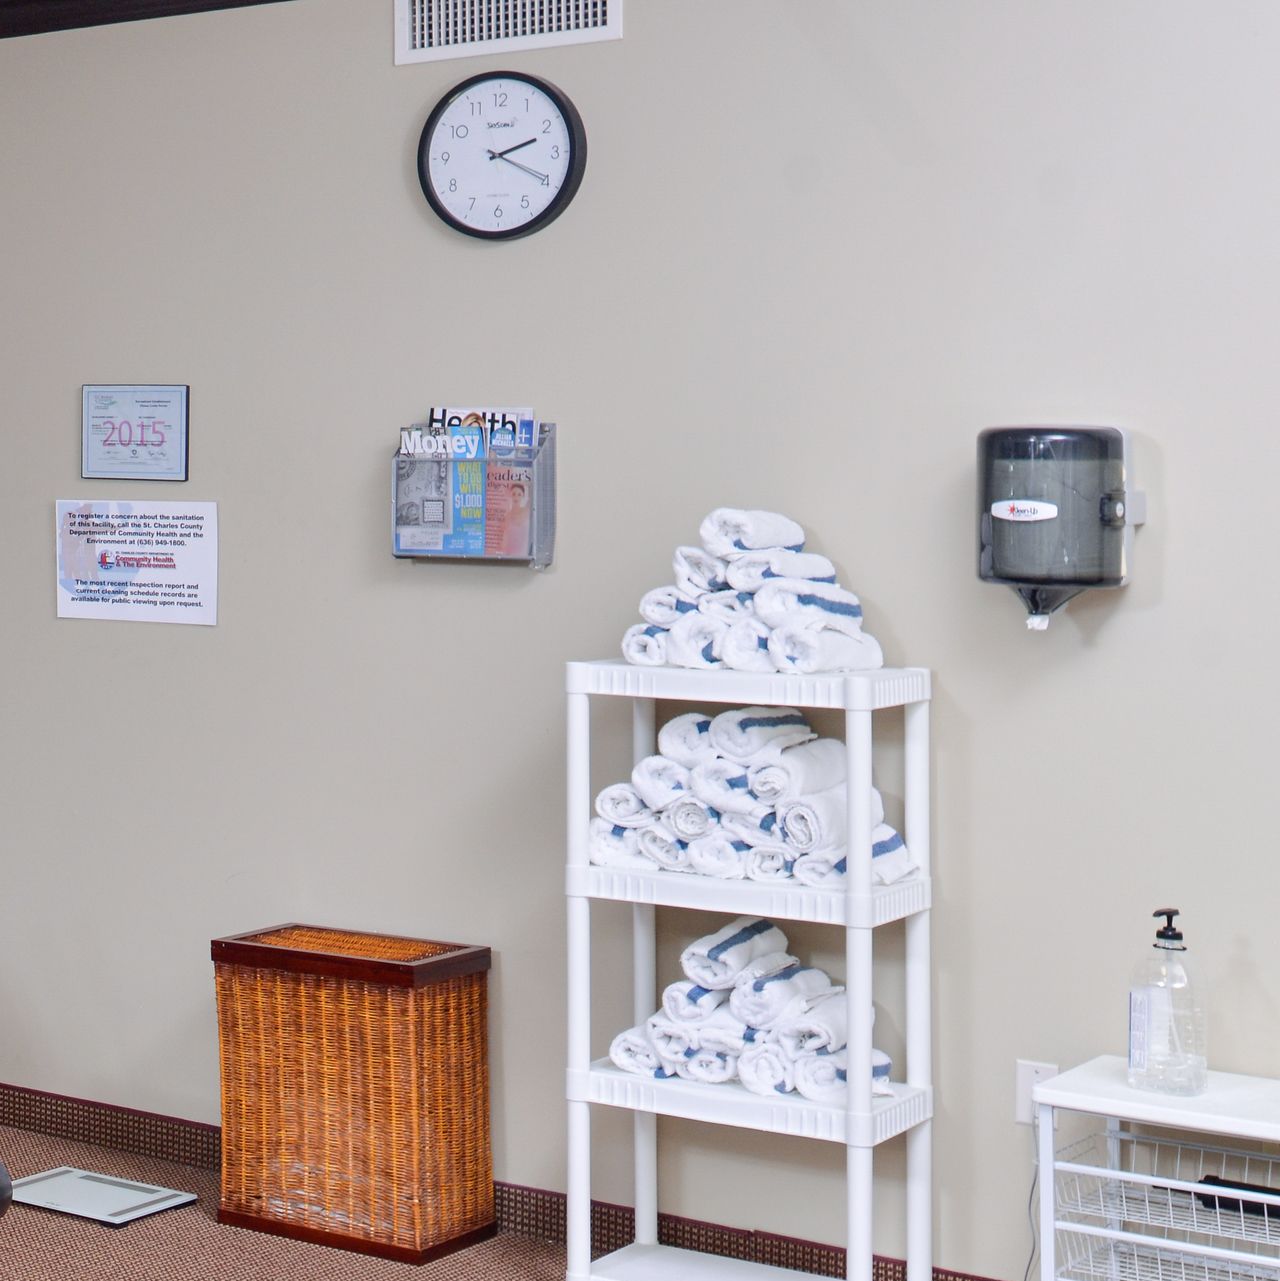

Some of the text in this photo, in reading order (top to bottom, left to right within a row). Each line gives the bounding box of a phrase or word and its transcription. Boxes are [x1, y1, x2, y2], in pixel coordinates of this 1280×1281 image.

[493, 93, 508, 107] 12
[470, 102, 482, 116] 11
[451, 125, 469, 139] 10
[542, 119, 552, 134] 2
[441, 152, 450, 165] 9
[550, 145, 560, 160] 3
[449, 178, 458, 193] 8
[541, 174, 550, 187] 4
[468, 197, 476, 211] 7
[520, 195, 530, 209] 5
[493, 205, 503, 218] 6
[102, 420, 165, 447] 2015
[400, 430, 480, 459] Money
[487, 469, 532, 482] eader's
[78, 513, 104, 521] register
[70, 529, 108, 537] Department
[118, 530, 155, 538] Community
[115, 555, 151, 563] Community
[129, 581, 164, 589] inspection
[165, 582, 185, 590] report
[101, 589, 128, 597] cleaning
[111, 597, 131, 605] public
[132, 598, 158, 606] viewing
